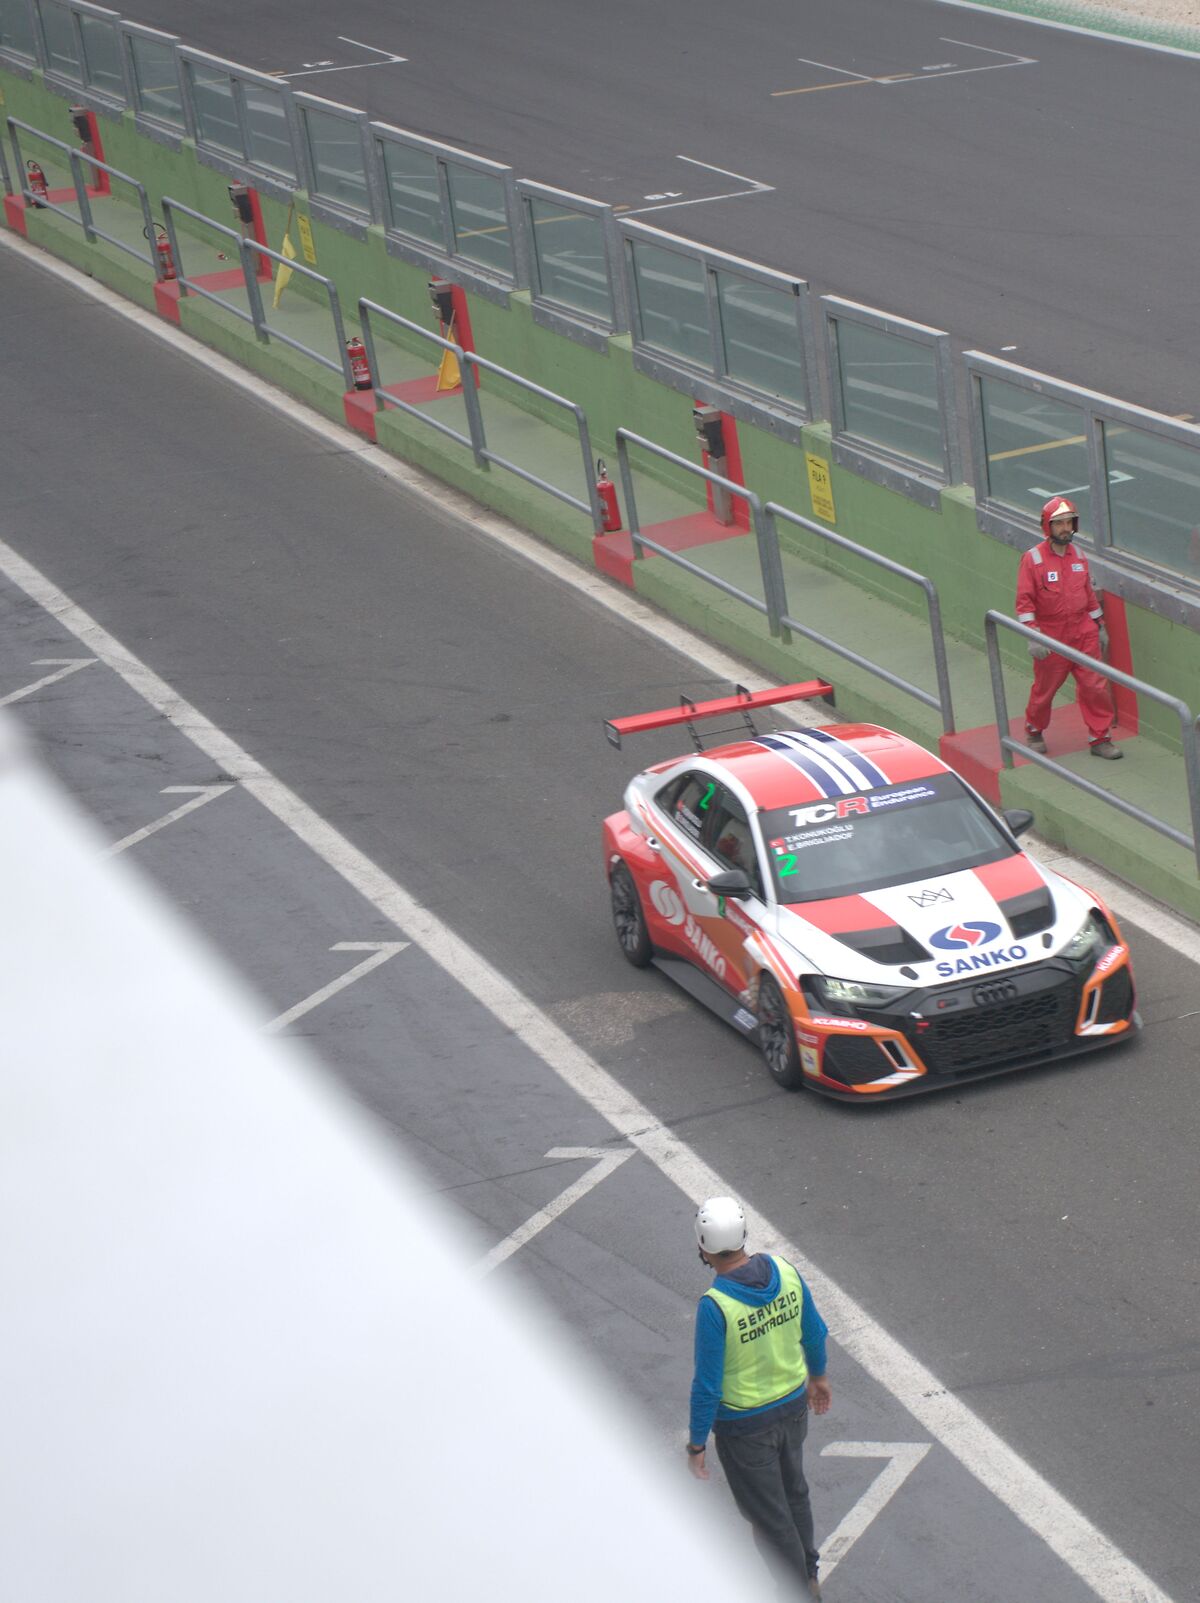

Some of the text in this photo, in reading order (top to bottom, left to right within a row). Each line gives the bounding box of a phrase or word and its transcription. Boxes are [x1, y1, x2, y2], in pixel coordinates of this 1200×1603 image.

[788, 790, 935, 827] TCR Endurance
[870, 786, 927, 801] European
[776, 853, 799, 878] 2
[684, 915, 726, 980] SANKO
[936, 945, 1027, 977] SANKO
[1097, 945, 1125, 971] KUMHO
[813, 1018, 867, 1031] KUMHO
[738, 1291, 797, 1330] SERVIZIO
[740, 1305, 799, 1344] CONTROLLO
